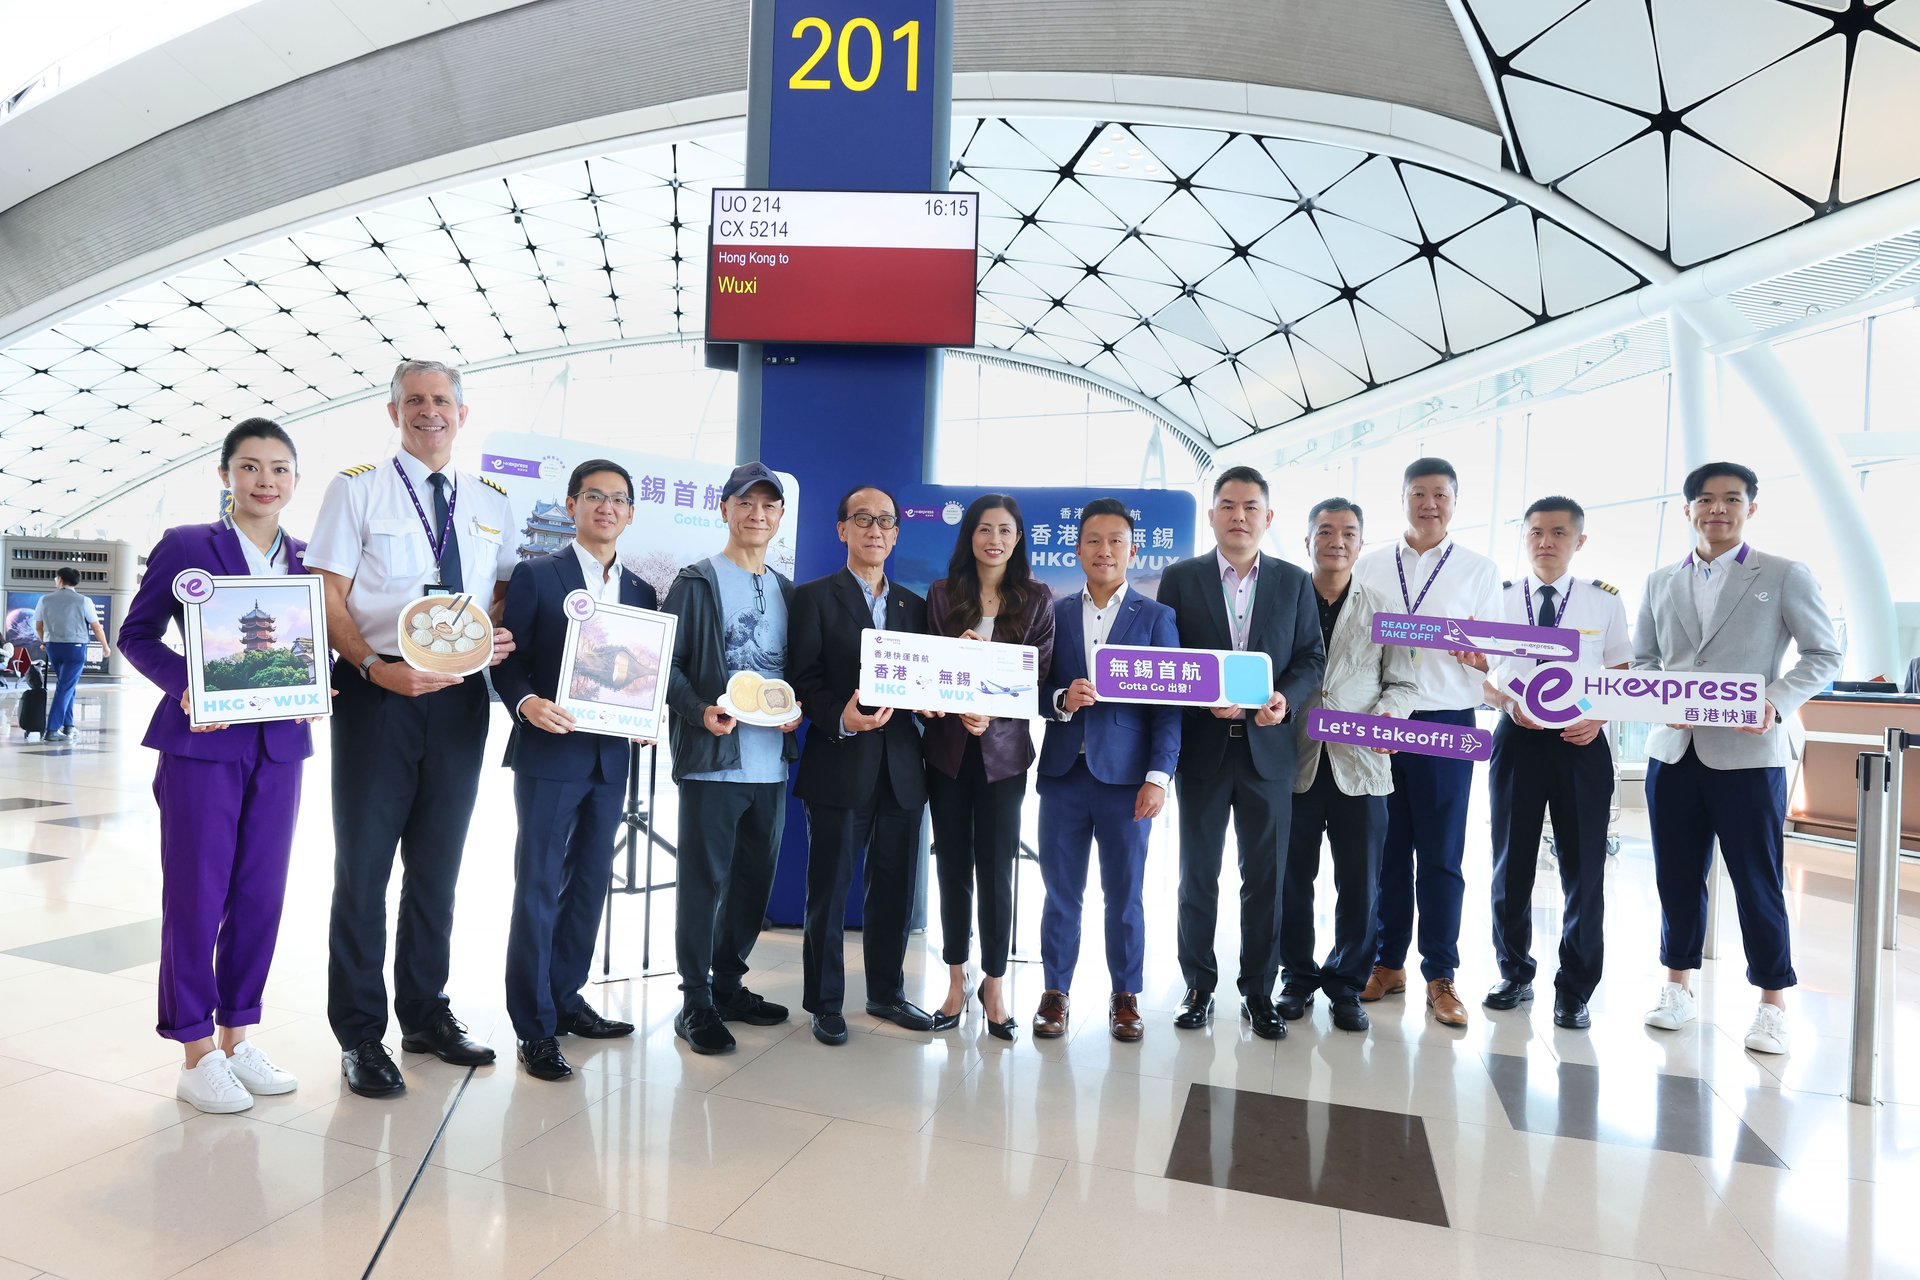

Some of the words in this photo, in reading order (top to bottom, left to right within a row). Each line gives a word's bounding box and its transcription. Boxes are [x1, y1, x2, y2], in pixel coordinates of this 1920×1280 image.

[789, 17, 920, 92] 201
[721, 196, 747, 213] UO
[752, 196, 781, 213] 214
[924, 199, 968, 217] 16:15
[720, 220, 744, 237] CX
[749, 221, 788, 238] 5214
[719, 252, 746, 266] Hong
[749, 252, 776, 267] Kong
[779, 253, 789, 264] to
[718, 276, 757, 294] Wuxi
[630, 475, 723, 511] 錫首航
[674, 513, 710, 528] Gotta
[1031, 524, 1079, 546] 香港
[1031, 551, 1076, 567] HKG
[1380, 629, 1407, 639] TAKE
[1409, 631, 1434, 642] OFF!
[1381, 620, 1417, 631] READY
[1419, 623, 1442, 633] FOR
[874, 650, 930, 663] 香港快運首航
[874, 664, 907, 681] 香港
[939, 669, 971, 687] 無錫
[1109, 658, 1202, 681] 無錫首航
[874, 683, 907, 696] HKG
[939, 688, 975, 702] WUX
[1119, 681, 1148, 691] Gotta
[1150, 683, 1165, 692] Go
[1584, 676, 1758, 704] HKexpress
[204, 698, 245, 713] HKG
[273, 693, 320, 707] WUX
[618, 713, 653, 728] WUX
[1684, 707, 1758, 724] 香港快運
[1318, 718, 1366, 737] Let's
[1372, 725, 1455, 749] takeoff!
